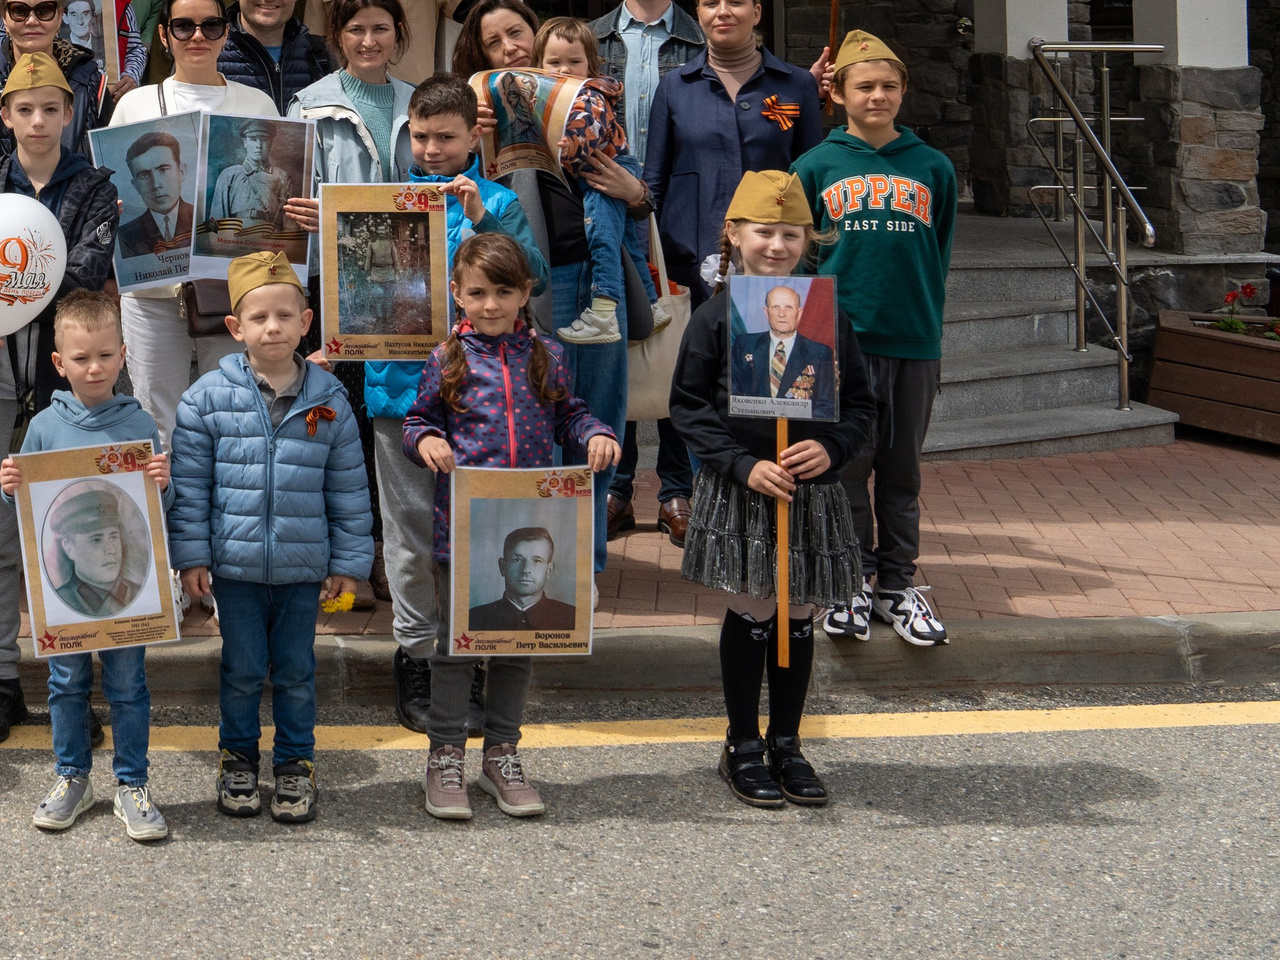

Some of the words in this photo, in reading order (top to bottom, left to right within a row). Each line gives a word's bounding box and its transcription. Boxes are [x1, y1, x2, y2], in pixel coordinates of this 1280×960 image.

[500, 161, 517, 172] ПОЛК
[418, 193, 429, 212] 9
[821, 173, 932, 228] UPPER
[844, 220, 879, 231] EAST
[886, 221, 915, 232] SIDE
[157, 252, 190, 264] Чернов
[134, 267, 173, 281] Николай
[384, 341, 411, 349] Пахтусов
[731, 396, 767, 405] Яковенко
[769, 399, 809, 408] Александр
[731, 406, 776, 415] Степанович
[123, 451, 137, 472] 9
[563, 477, 576, 498] 9
[534, 632, 571, 640] Воронов
[60, 641, 83, 649] ПОЛК
